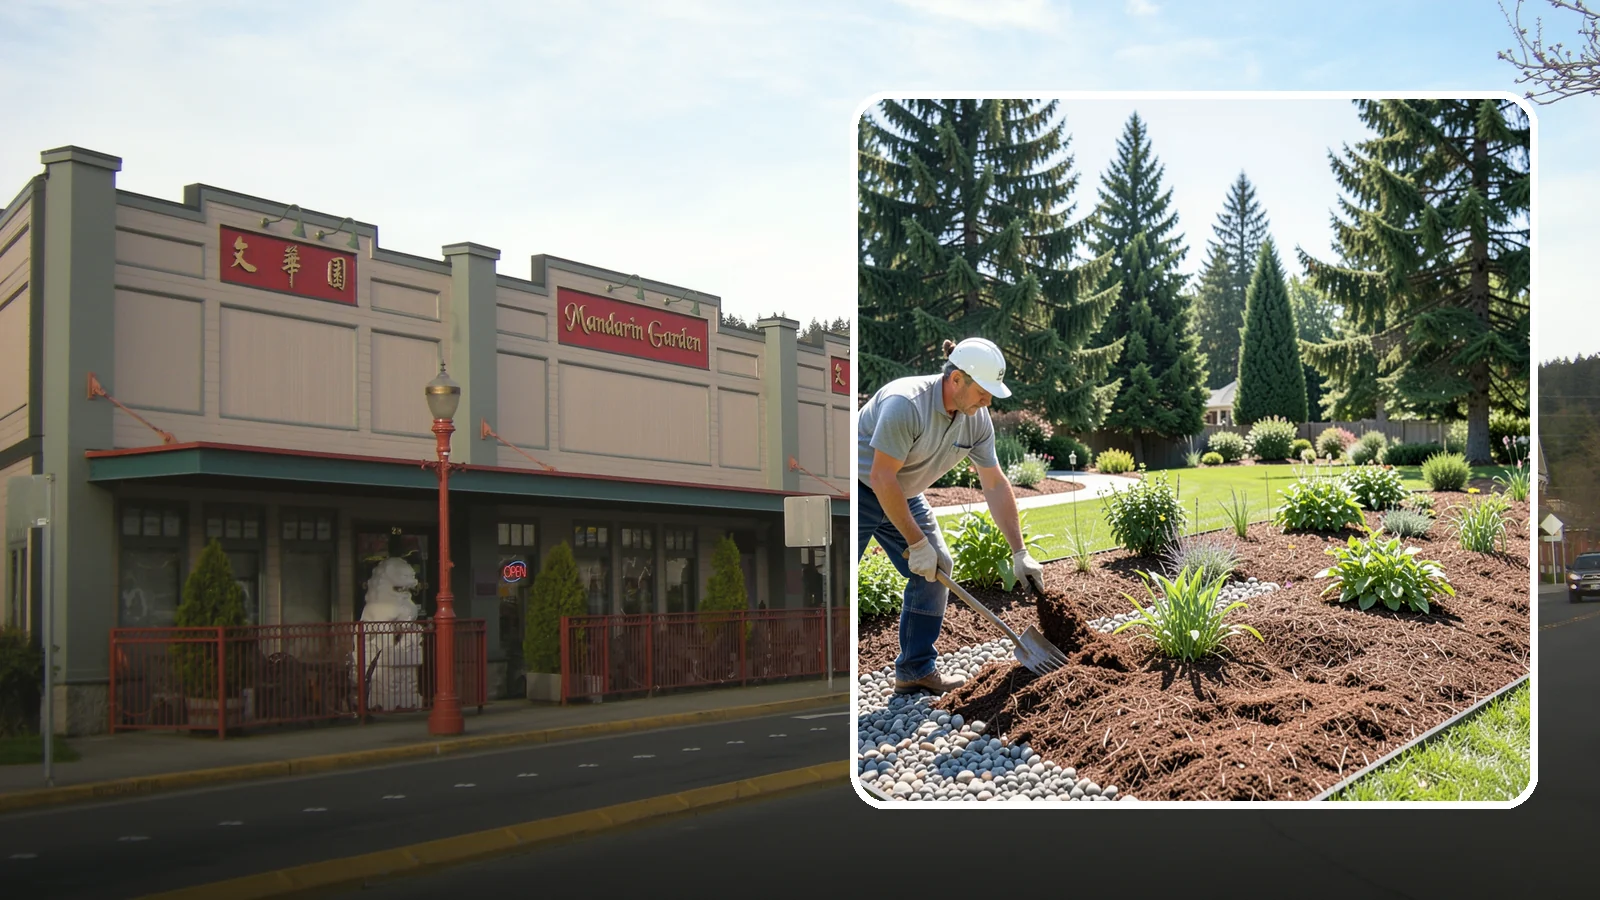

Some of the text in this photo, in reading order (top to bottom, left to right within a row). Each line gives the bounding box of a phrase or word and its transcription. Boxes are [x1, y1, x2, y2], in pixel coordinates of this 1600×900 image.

[230, 235, 347, 291] 文華園
[564, 302, 702, 352] Mandarin Garden
[503, 565, 527, 578] OPEN
